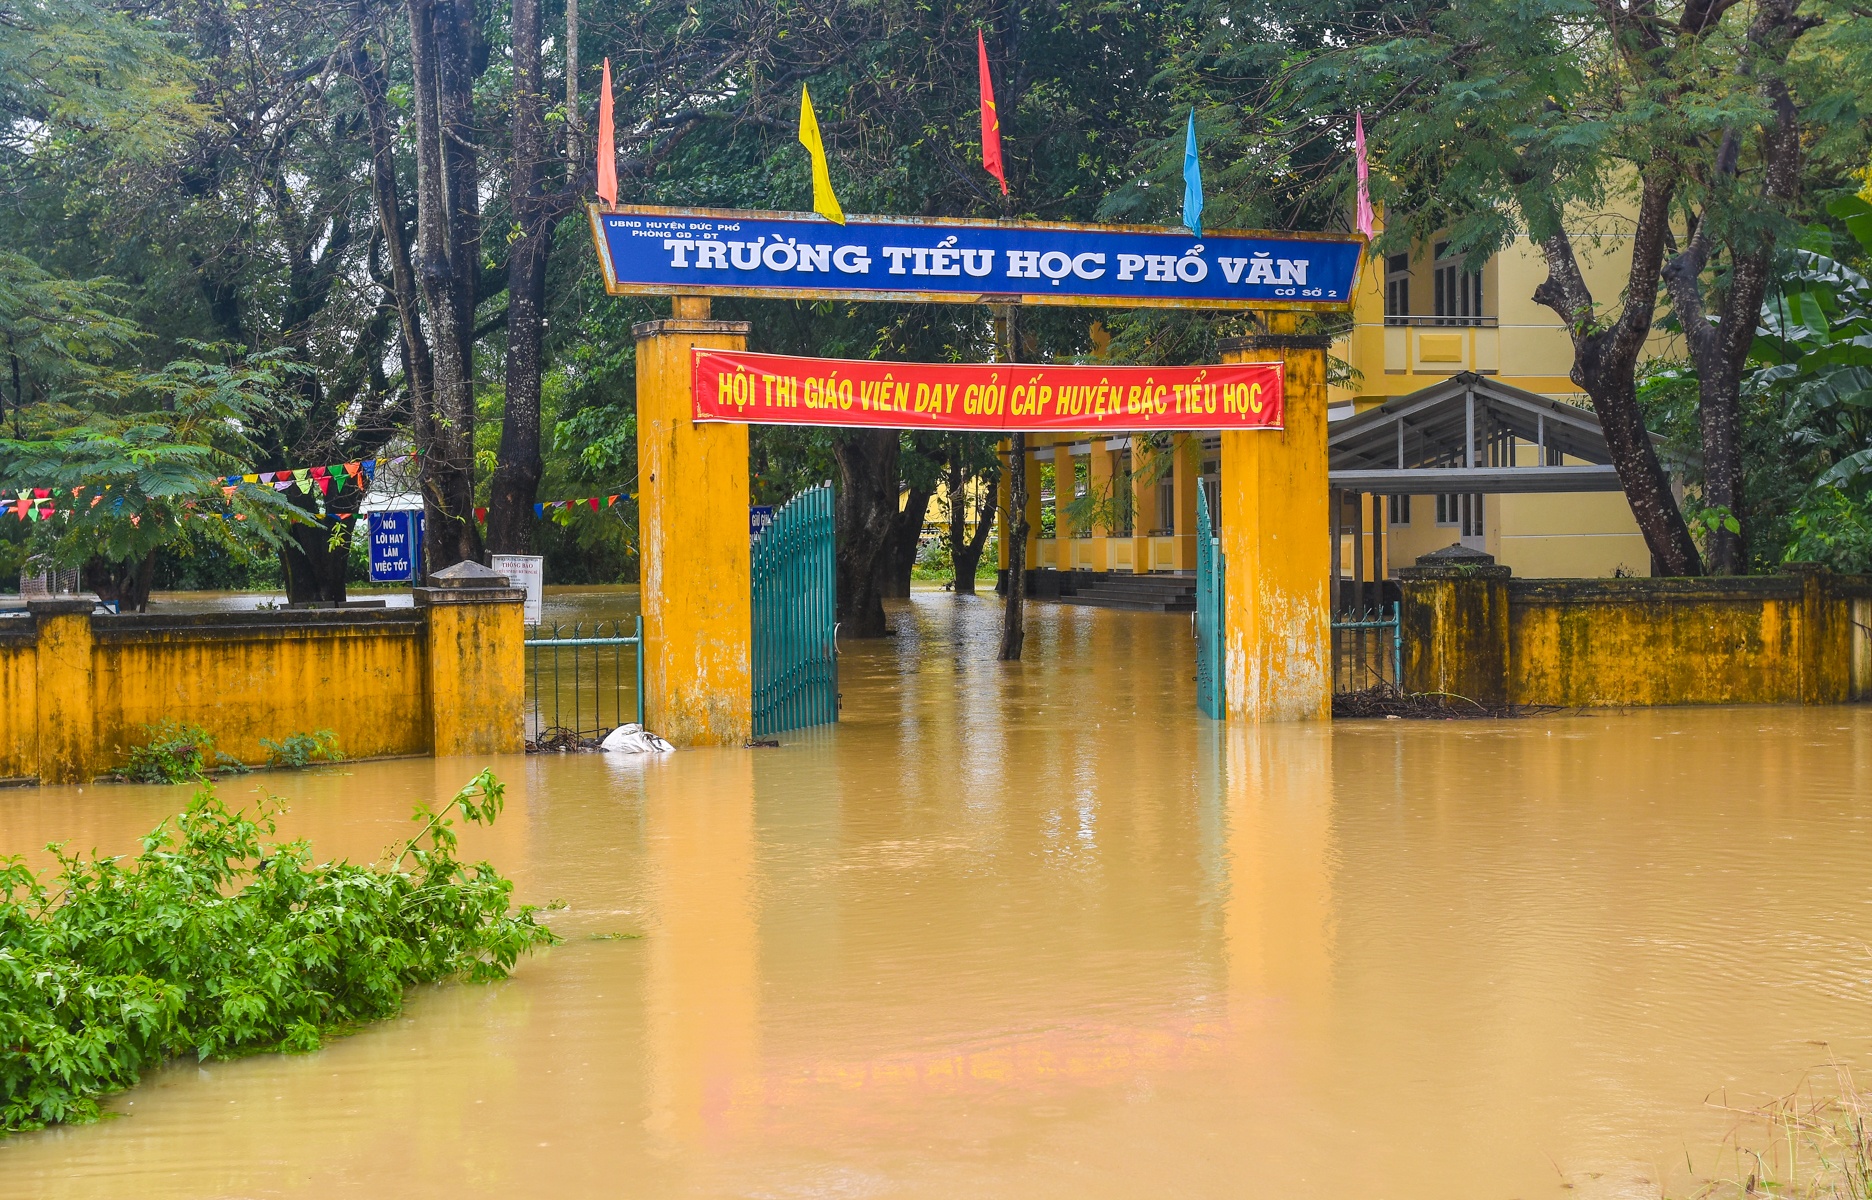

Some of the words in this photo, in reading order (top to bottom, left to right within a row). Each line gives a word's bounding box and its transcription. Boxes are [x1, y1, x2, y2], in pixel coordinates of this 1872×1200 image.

[609, 220, 642, 228] UBND
[646, 221, 686, 230] HUYỆN
[689, 222, 713, 231] ĐỨC
[632, 229, 672, 238] PHÒNG
[676, 231, 692, 239] GD
[703, 232, 719, 240] ĐT
[663, 233, 872, 274] TRƯỜNG
[882, 235, 996, 277] TIỂU
[1006, 249, 1107, 286] HỌC
[1117, 244, 1208, 283] PHỔ
[1217, 251, 1309, 286] VĂN
[1274, 287, 1296, 296] CƠ
[1327, 289, 1338, 298] 2
[718, 364, 756, 413] HỘI
[762, 374, 798, 408] THI
[803, 370, 854, 411] GIÁO
[860, 372, 910, 412] VIÊN
[914, 382, 960, 420] DẠY
[963, 372, 1007, 416] GIỎI
[1010, 373, 1053, 416] CẤP
[1055, 377, 1125, 421] HUYỆN
[1127, 376, 1168, 421] BẬC
[1172, 369, 1218, 414] TIỂU
[1223, 382, 1263, 420] HỌC
[382, 517, 396, 530] NÓI
[375, 532, 388, 545] LỜI
[389, 533, 405, 544] HAY
[383, 545, 399, 557] LÀM
[374, 560, 392, 574] VIỆC
[393, 558, 408, 571] TỐT
